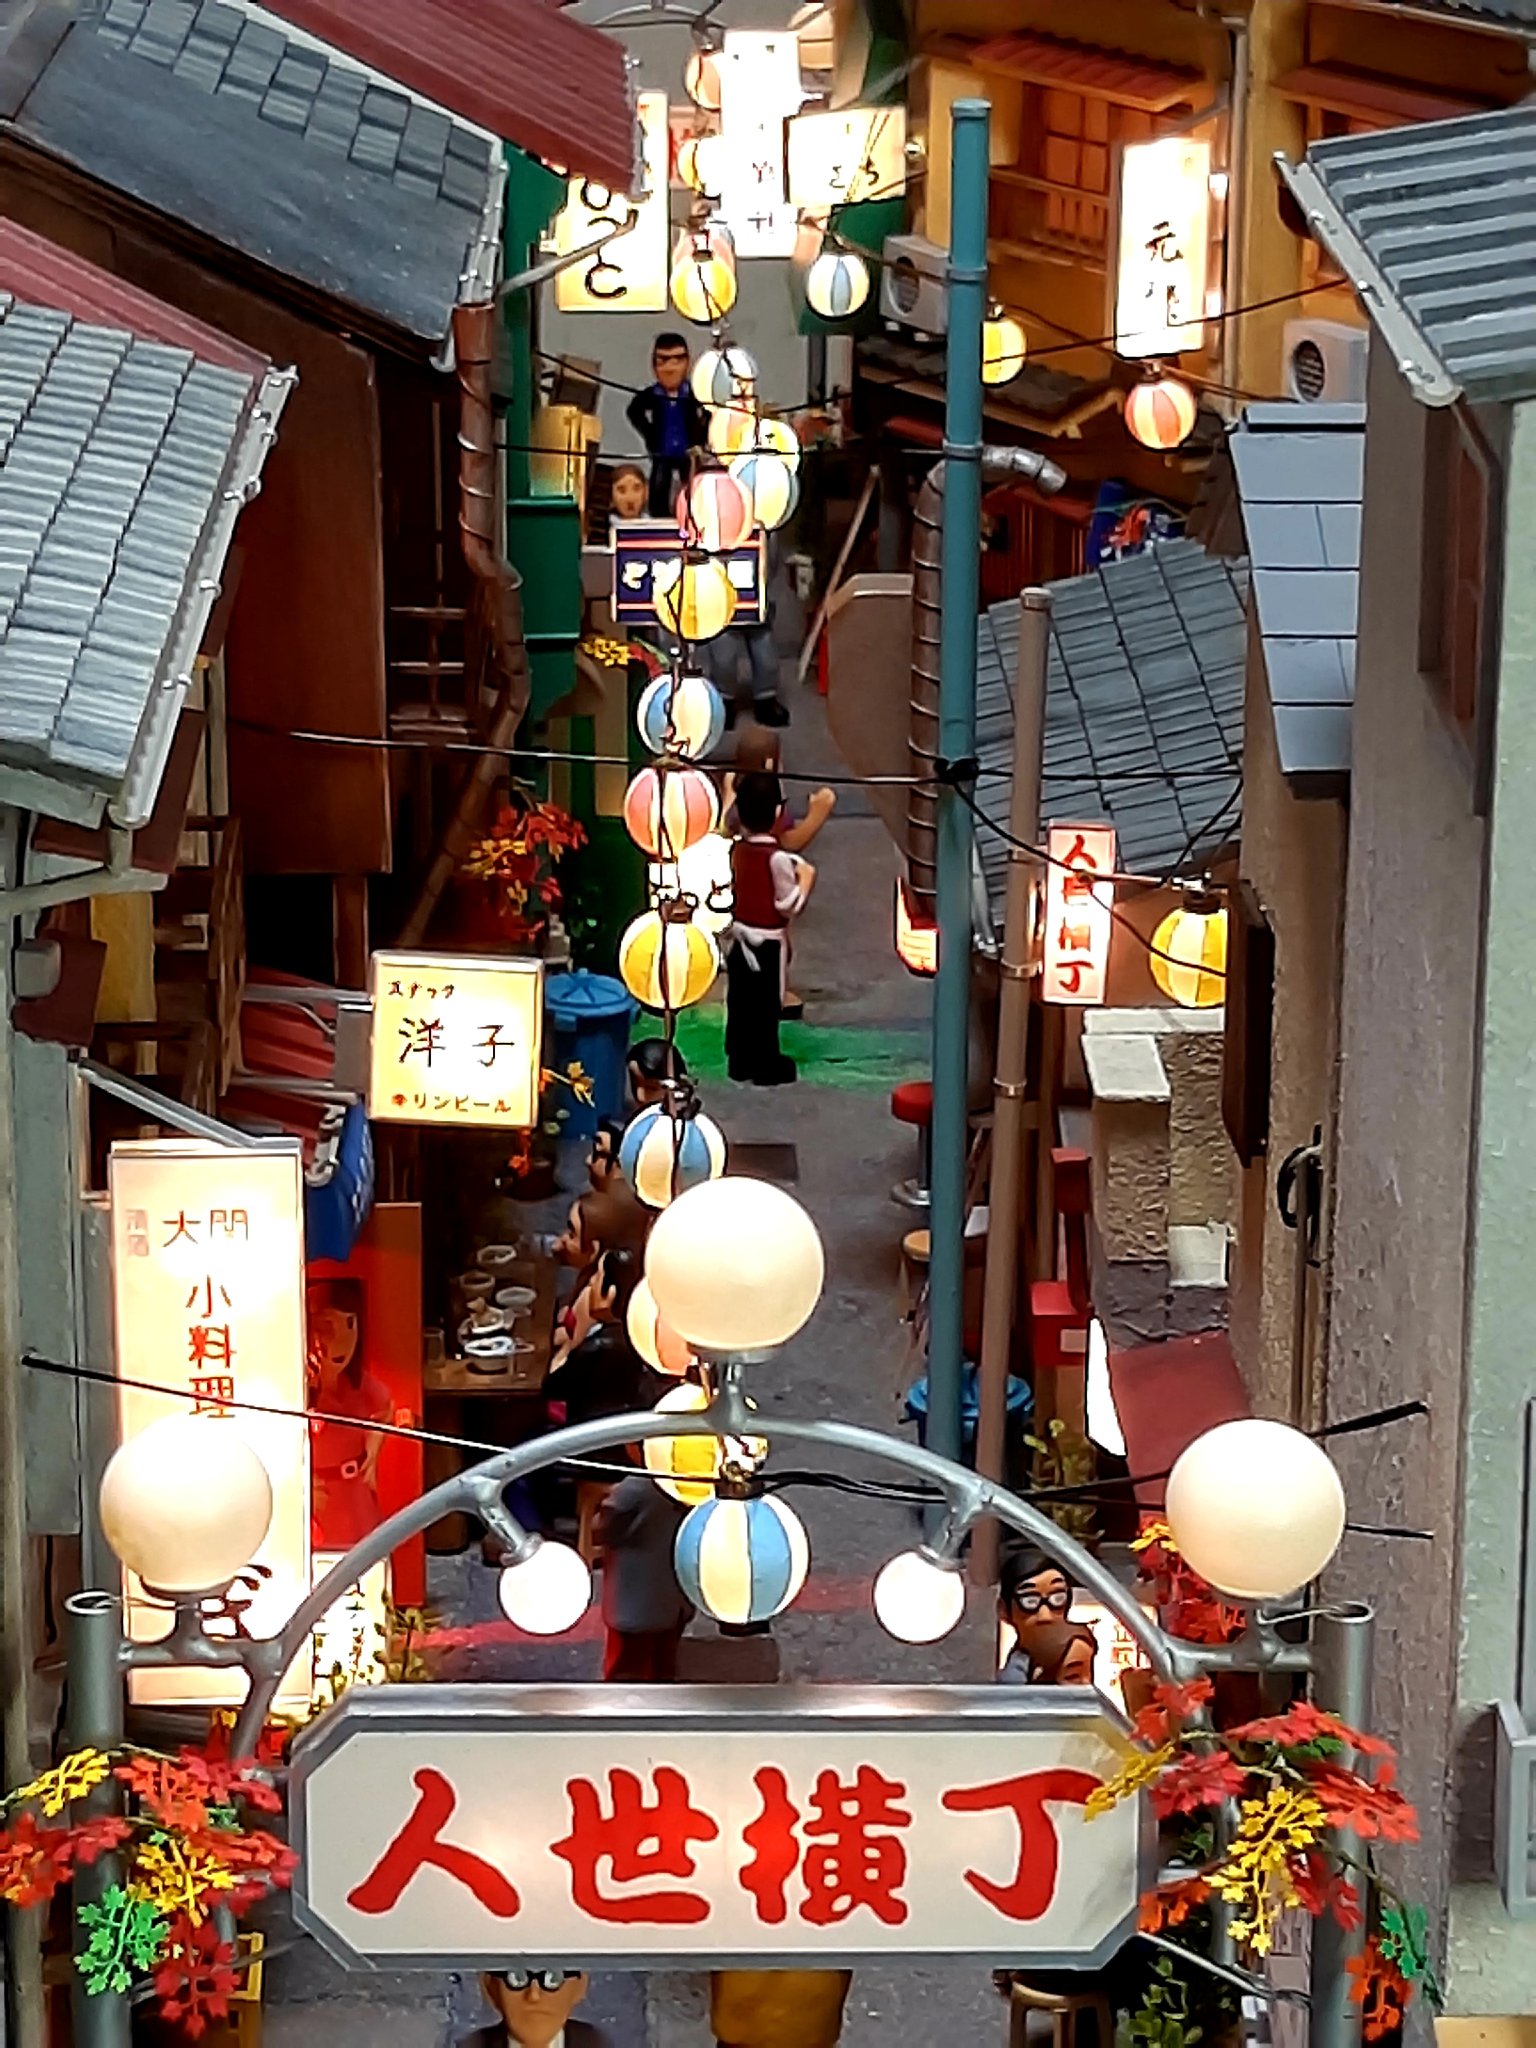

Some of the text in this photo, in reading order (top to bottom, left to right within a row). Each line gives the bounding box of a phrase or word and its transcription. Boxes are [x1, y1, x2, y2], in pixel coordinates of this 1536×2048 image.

[398, 1017, 515, 1067] 洋子
[185, 1274, 236, 1418] 小料理
[345, 1764, 1102, 1926] 人世横丁
